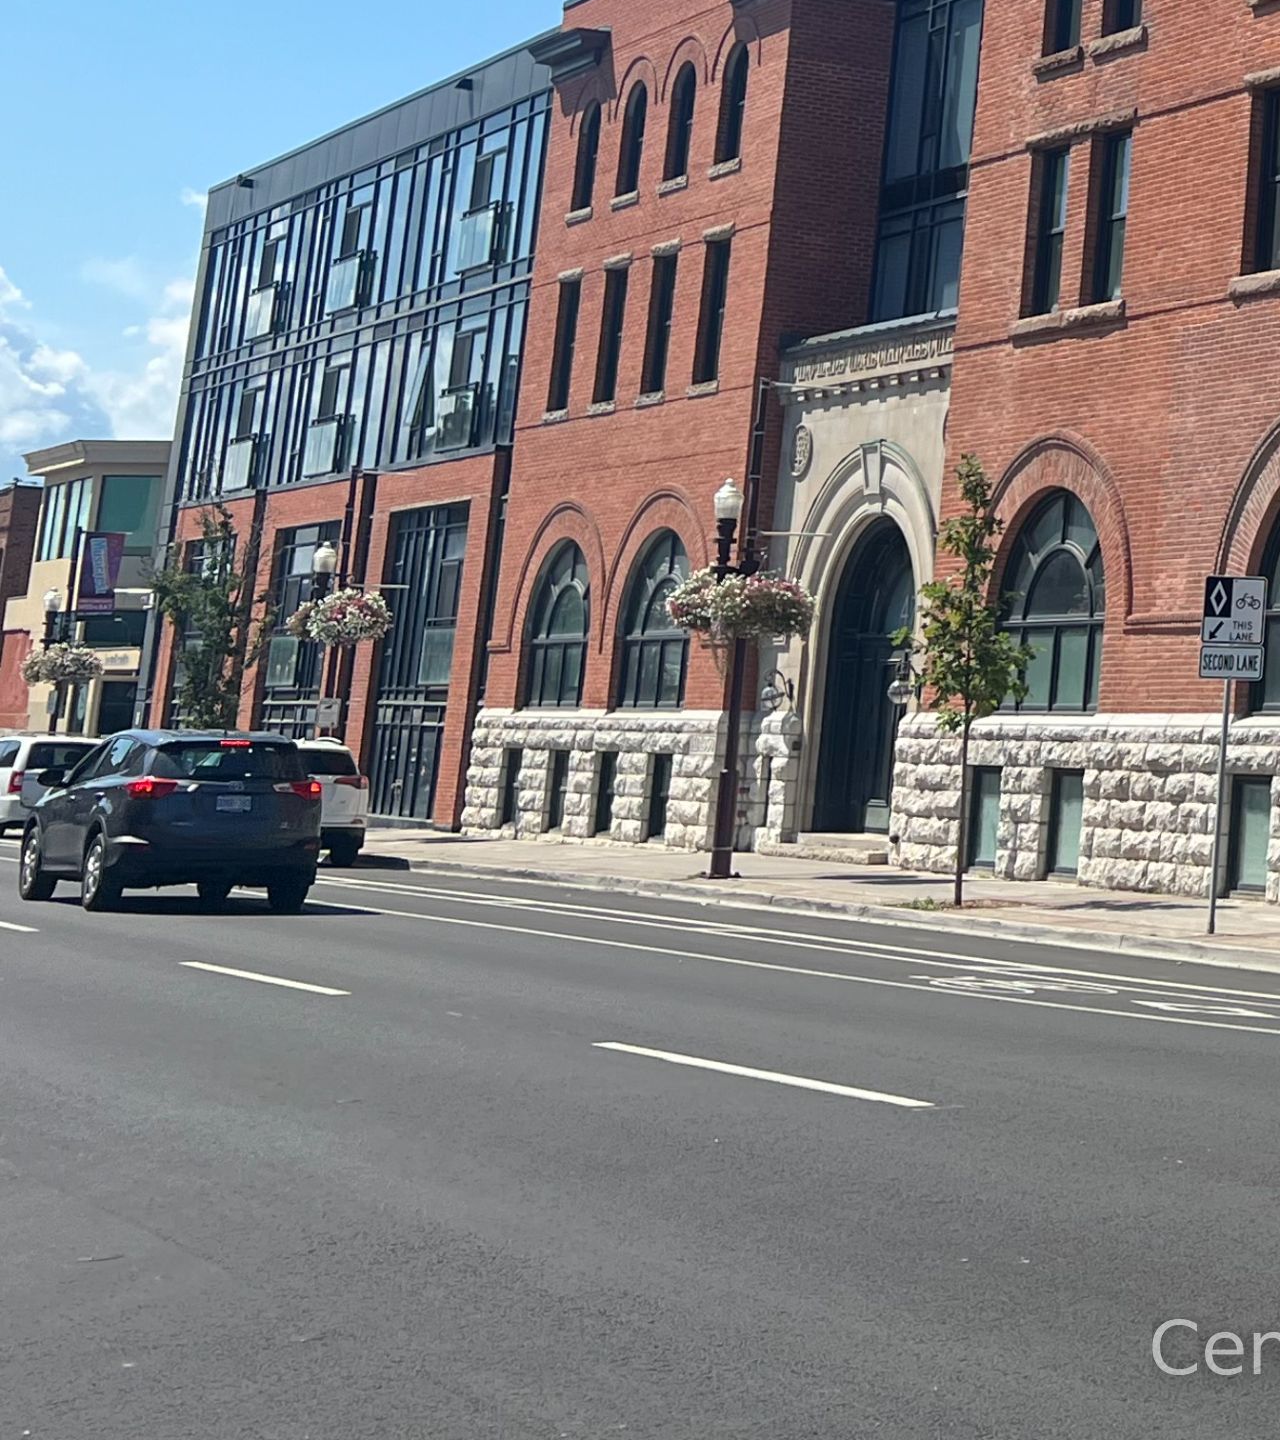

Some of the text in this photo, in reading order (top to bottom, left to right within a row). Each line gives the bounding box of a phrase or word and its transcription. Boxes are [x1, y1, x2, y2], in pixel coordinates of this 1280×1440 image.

[1232, 620, 1253, 631] THIS
[1229, 632, 1254, 642] LANE
[1203, 653, 1259, 672] SECOND LANE
